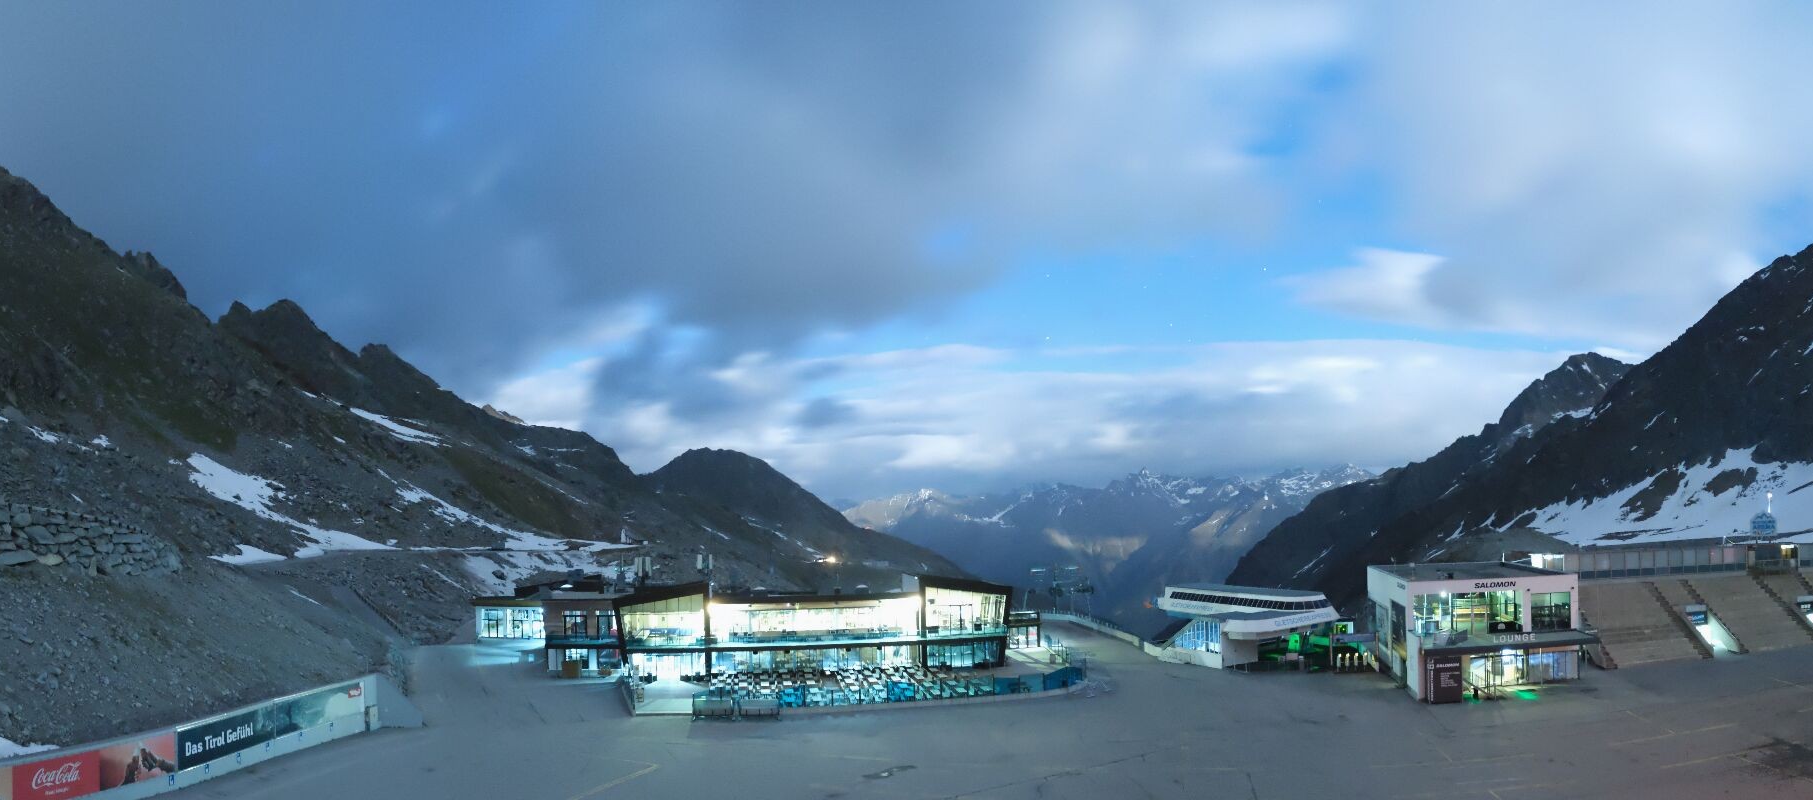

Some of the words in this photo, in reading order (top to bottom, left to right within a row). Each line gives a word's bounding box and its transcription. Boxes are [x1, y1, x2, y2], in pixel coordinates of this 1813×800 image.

[1474, 580, 1517, 589] SALOMON
[1492, 633, 1536, 643] LOUNGE
[185, 741, 203, 757] Das
[204, 731, 225, 751] Tirol
[226, 722, 254, 744] Gefühl
